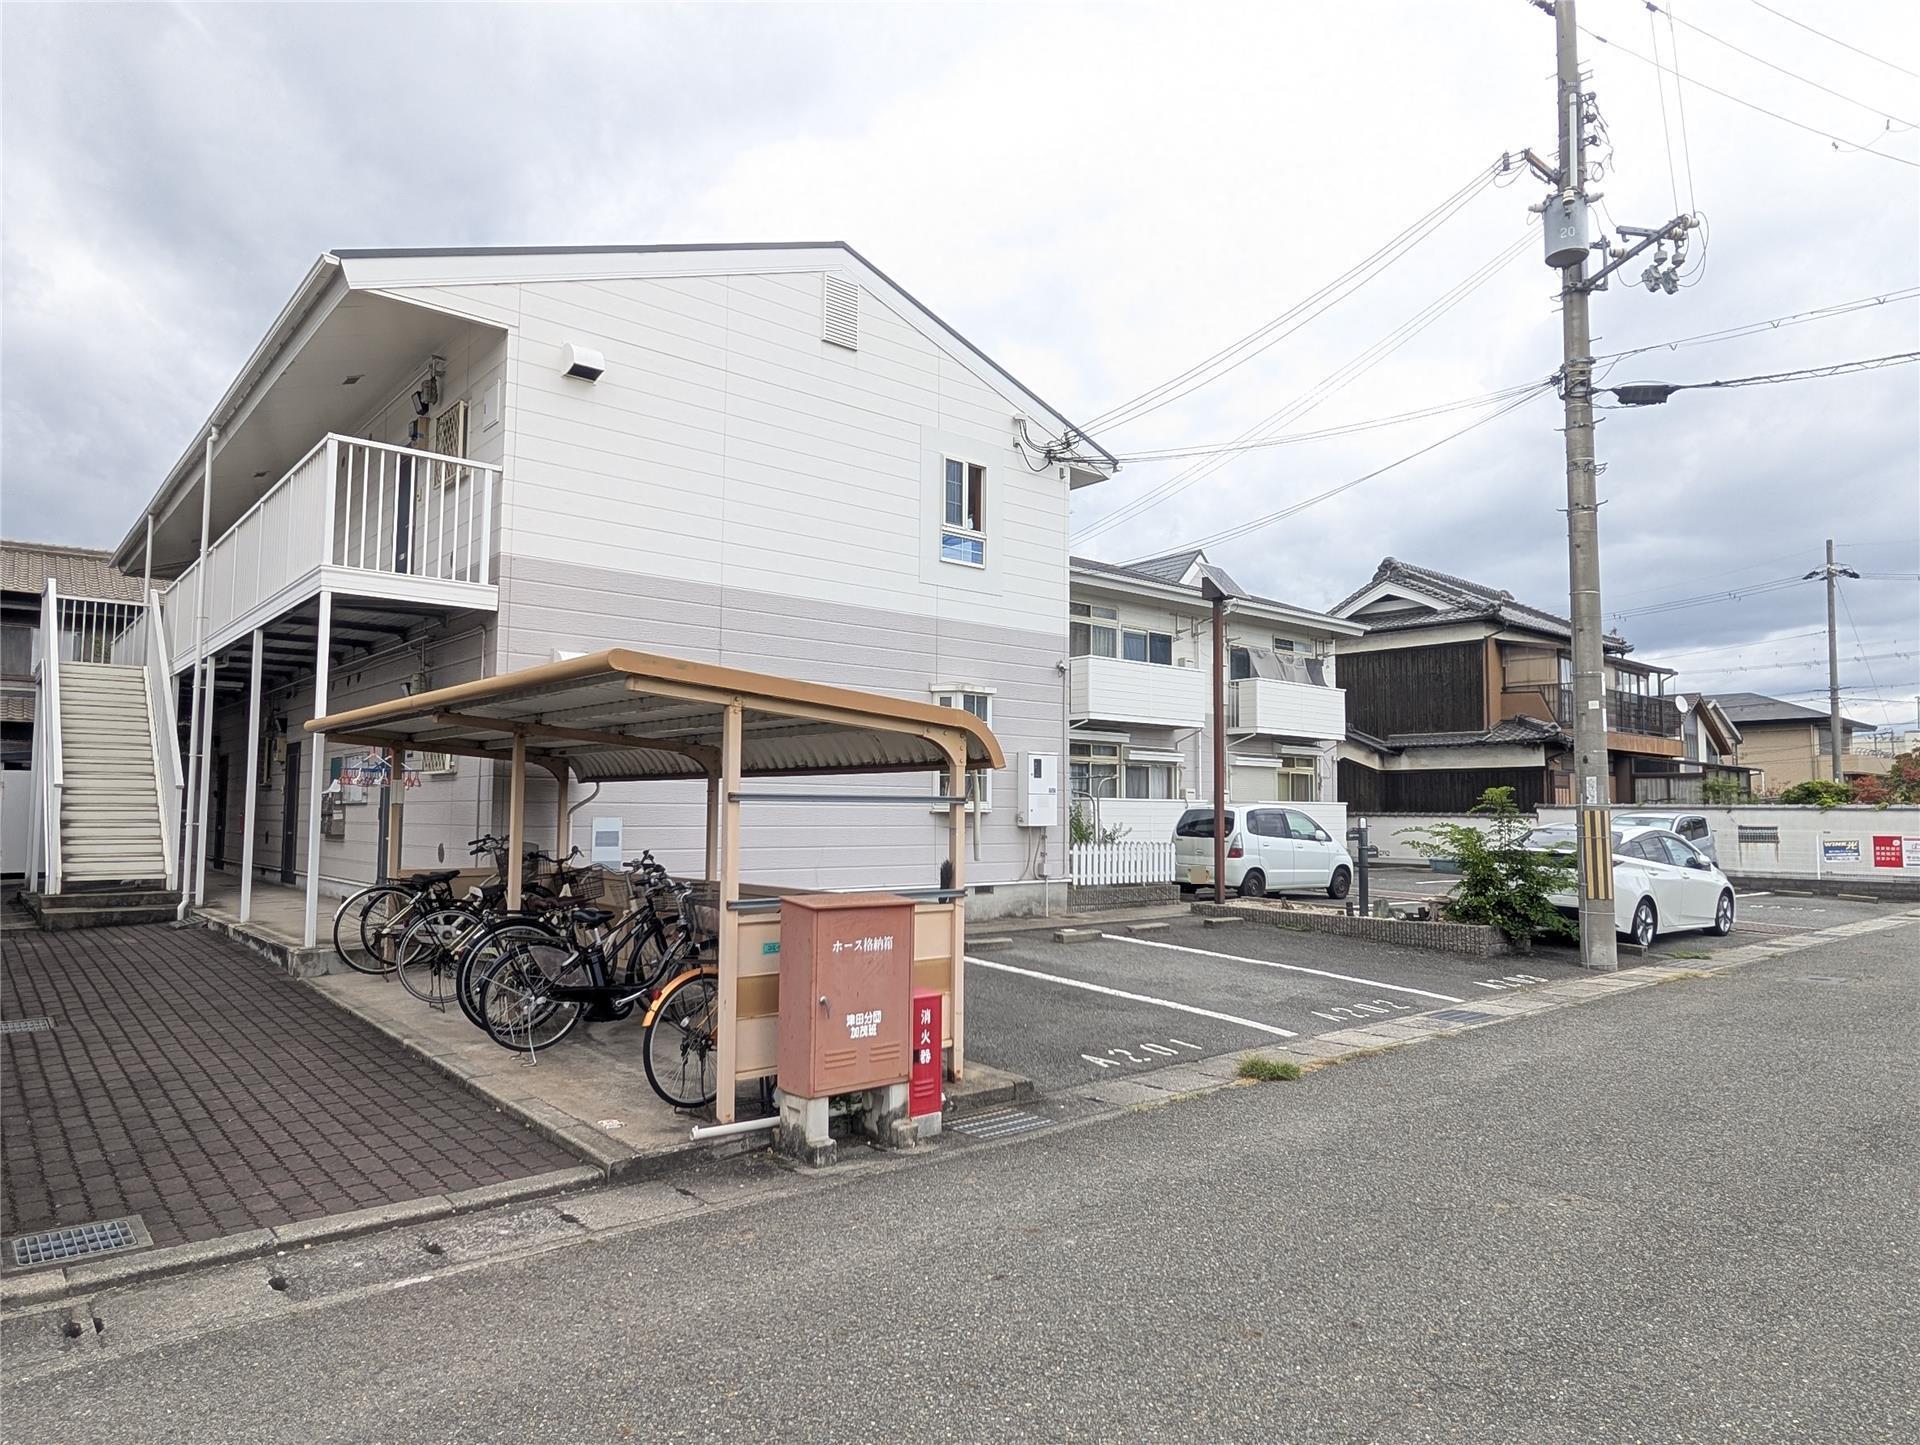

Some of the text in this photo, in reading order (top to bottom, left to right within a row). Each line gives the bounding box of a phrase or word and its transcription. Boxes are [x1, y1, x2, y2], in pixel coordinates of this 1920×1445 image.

[1560, 226, 1576, 239] 20
[832, 935, 894, 953] ホース格納箱
[846, 1010, 882, 1027] 津田分団
[1311, 999, 1411, 1022] A202
[850, 1023, 877, 1039] 加茂班
[919, 1008, 931, 1064] 消火器
[1081, 1038, 1202, 1068] A201
